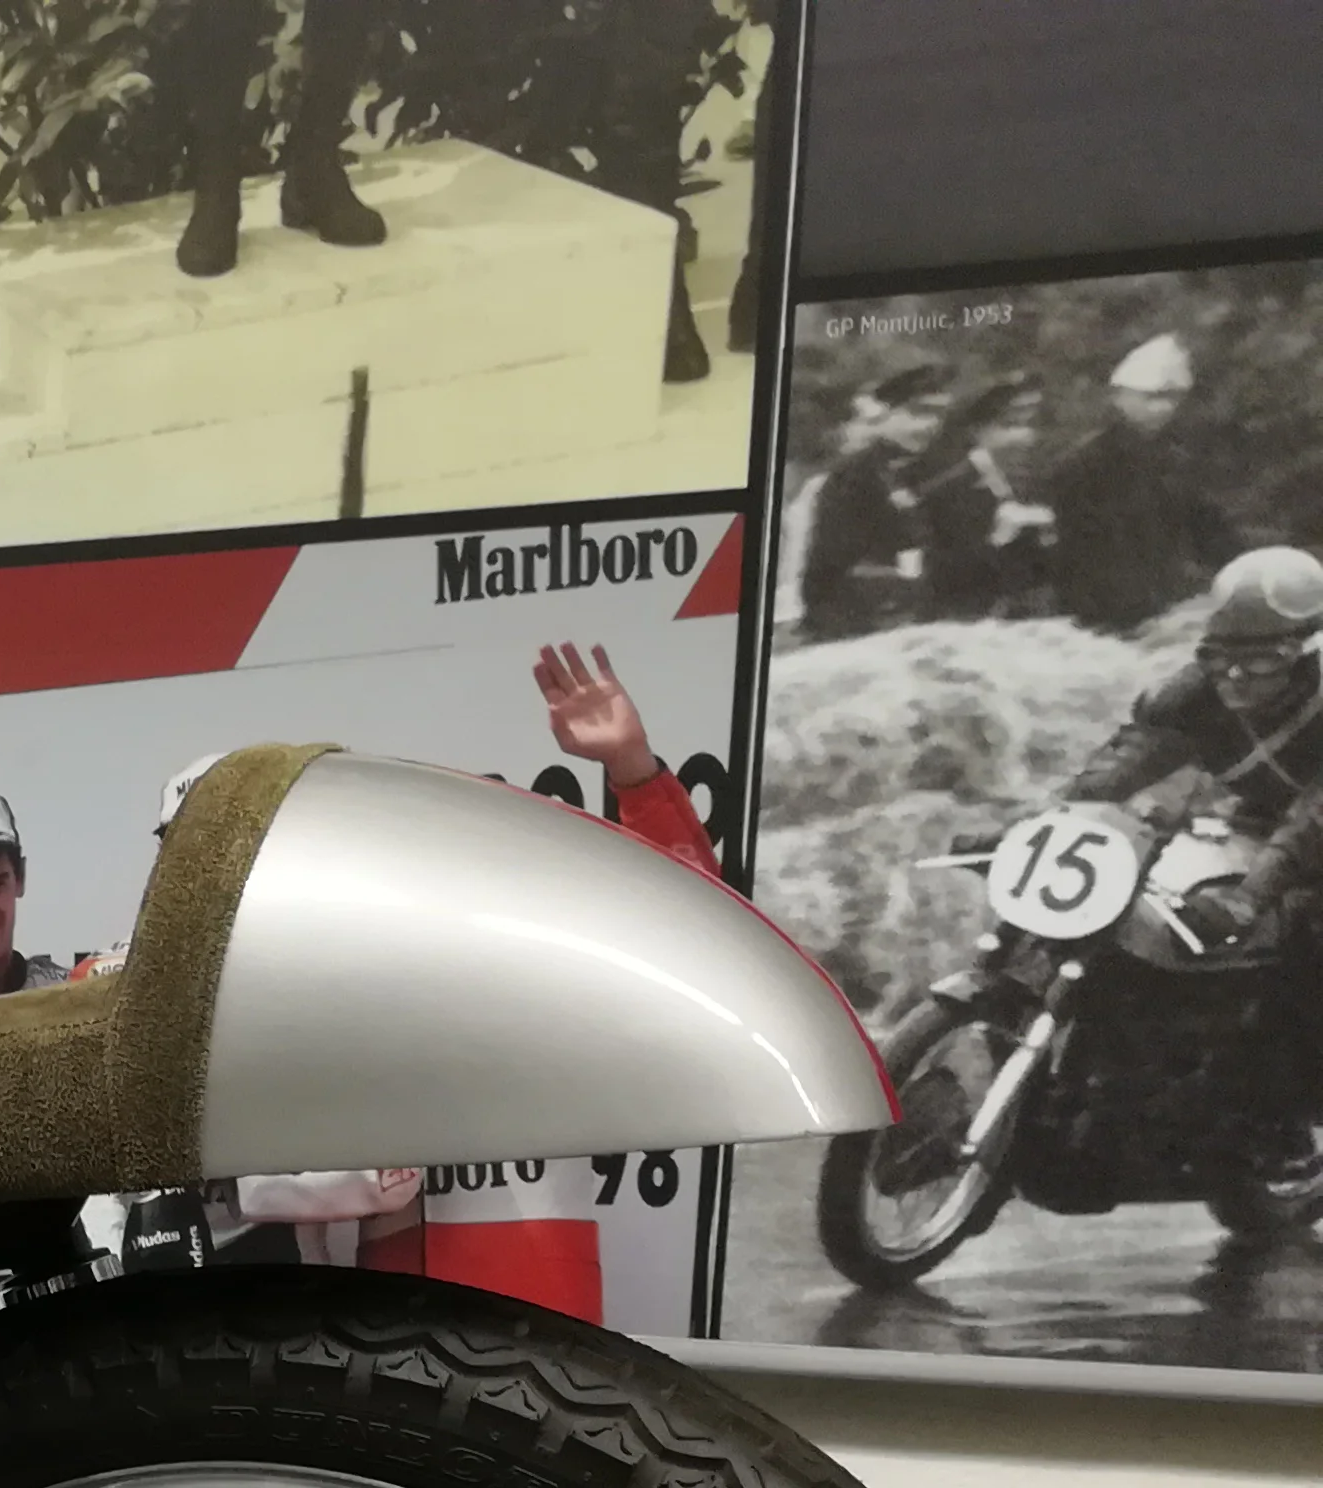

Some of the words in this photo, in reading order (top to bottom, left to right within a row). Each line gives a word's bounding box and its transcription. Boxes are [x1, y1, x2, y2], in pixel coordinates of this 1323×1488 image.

[825, 318, 854, 339] GP
[961, 303, 1015, 328] 1953
[434, 525, 699, 605] Marlboro
[1008, 823, 1111, 913] 15
